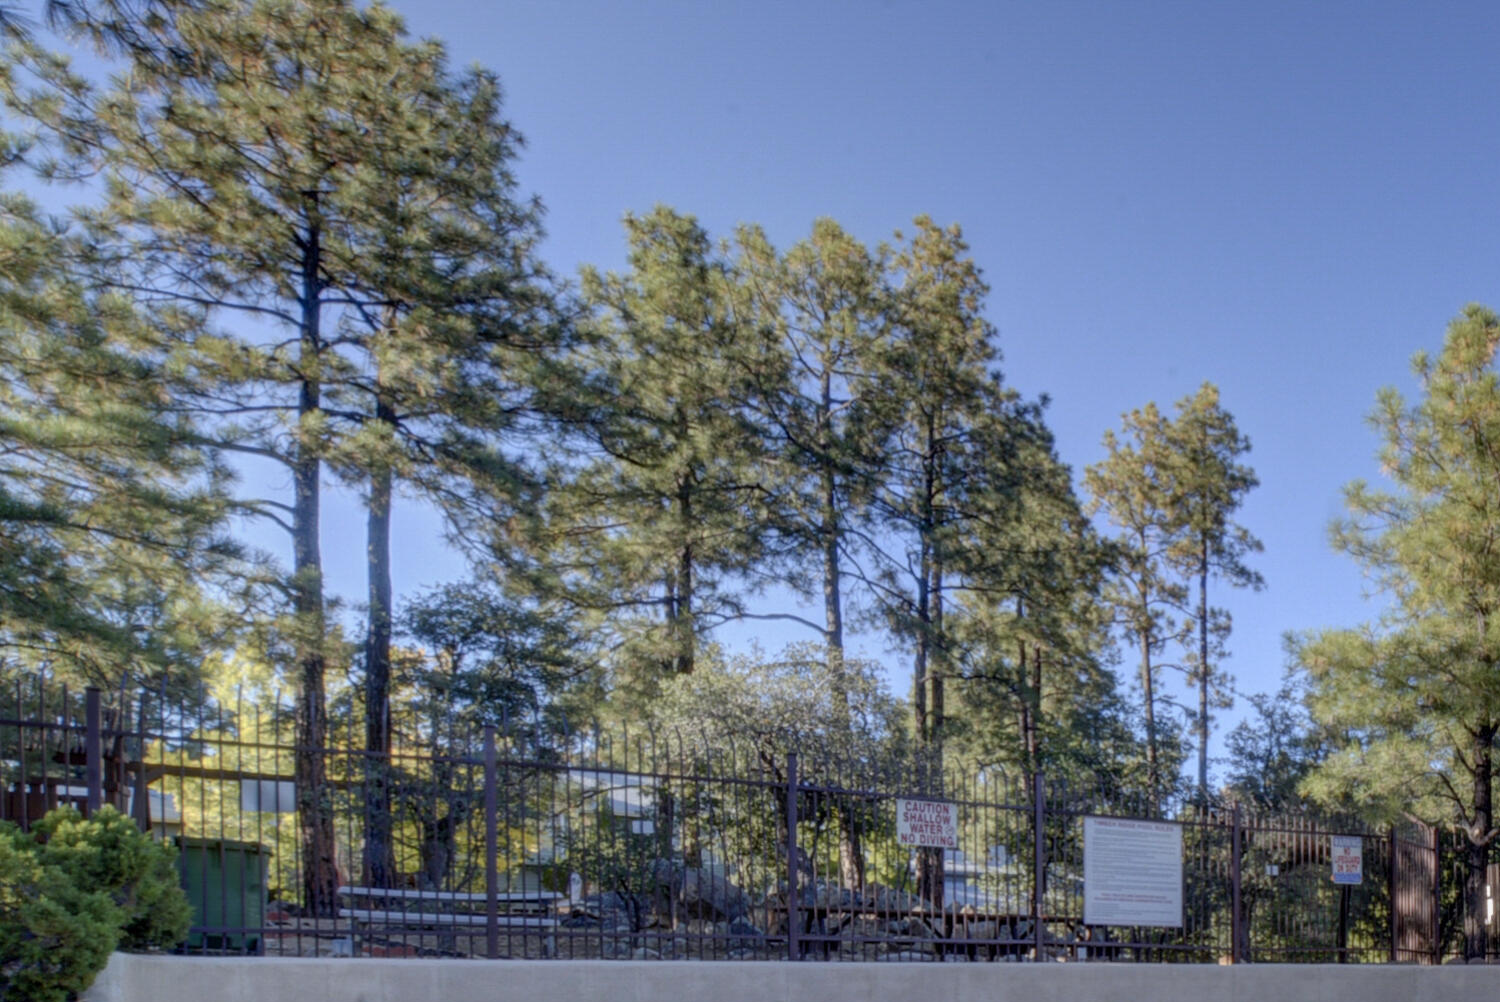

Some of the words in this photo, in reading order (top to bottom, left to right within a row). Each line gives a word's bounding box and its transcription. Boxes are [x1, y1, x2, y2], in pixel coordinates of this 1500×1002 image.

[905, 801, 949, 814] CAUTION
[903, 812, 951, 825] SHALLOW
[910, 823, 943, 835] WATER
[900, 832, 915, 843] NO
[919, 834, 954, 846] DIVING
